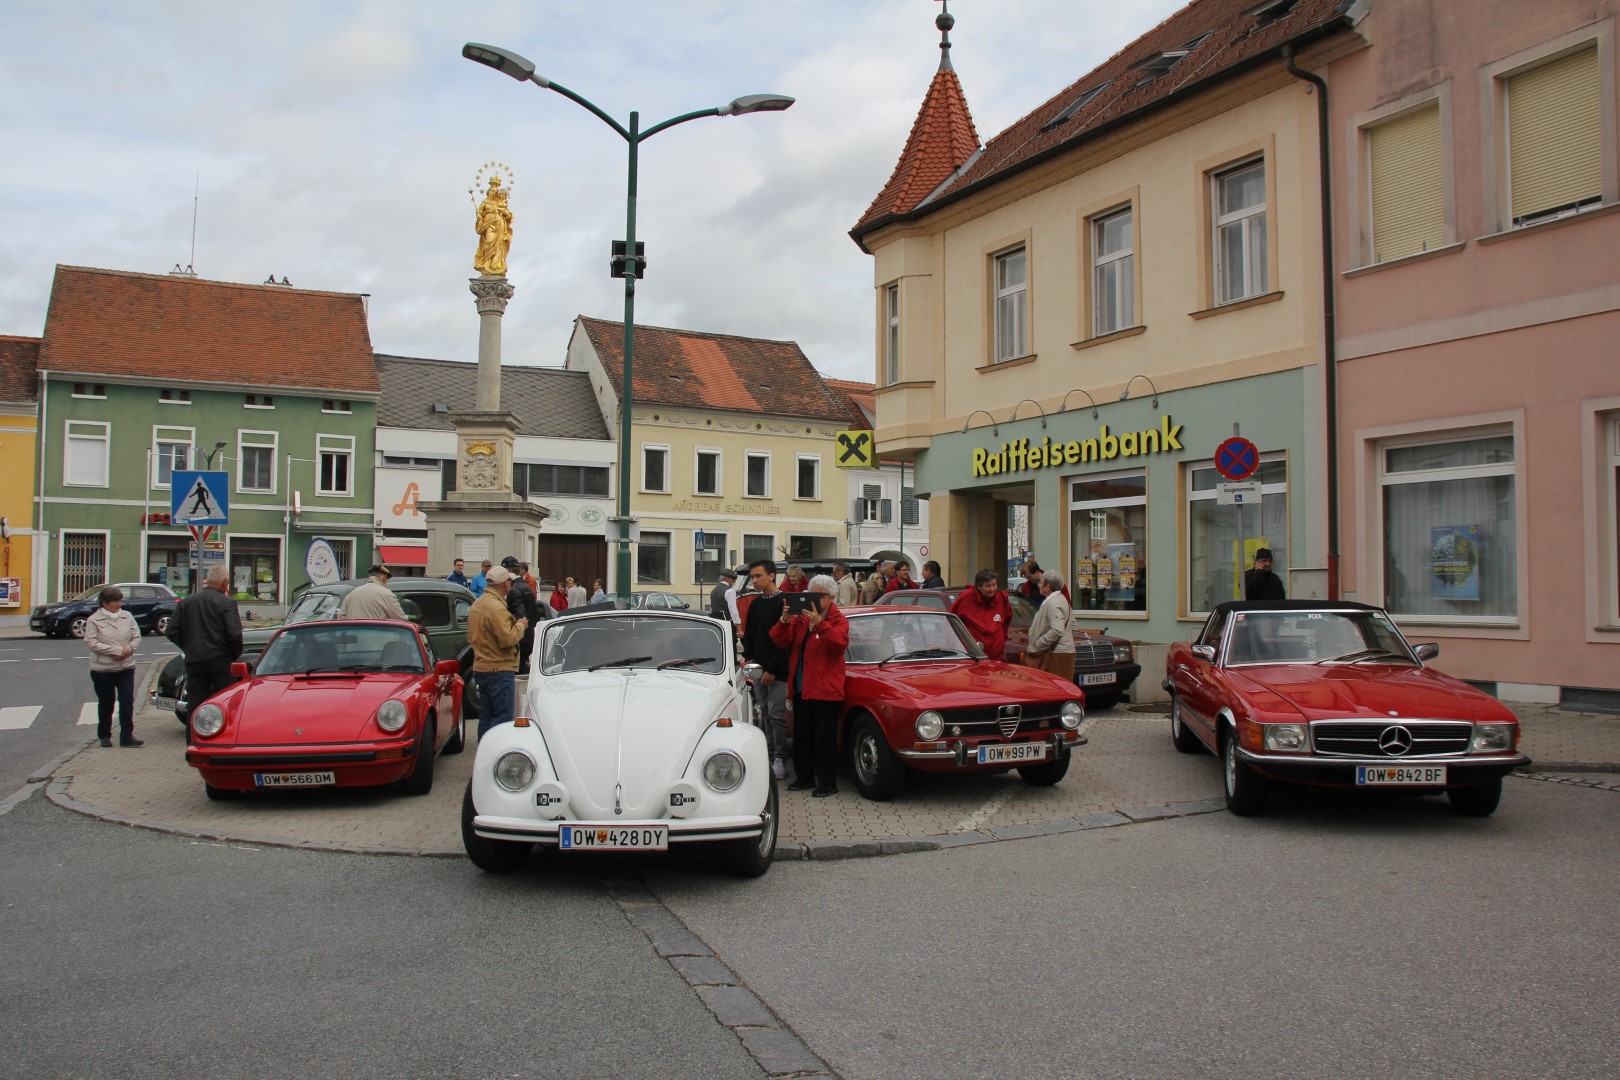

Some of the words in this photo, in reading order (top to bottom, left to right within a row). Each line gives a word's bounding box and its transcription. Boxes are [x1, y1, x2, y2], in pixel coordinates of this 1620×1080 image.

[972, 414, 1184, 477] Raiffeisenbank
[725, 504, 781, 515] SCHINDLER
[989, 748, 1004, 760] OW
[1012, 746, 1024, 758] 99
[1026, 745, 1040, 758] PW
[264, 775, 280, 784] OW
[290, 775, 313, 784] 566
[315, 774, 331, 783] DM
[1367, 769, 1386, 781] OW
[1397, 769, 1422, 781] 842
[1425, 769, 1442, 781] BF
[574, 829, 596, 845] OW
[609, 830, 639, 846] 428
[643, 830, 662, 845] DY
